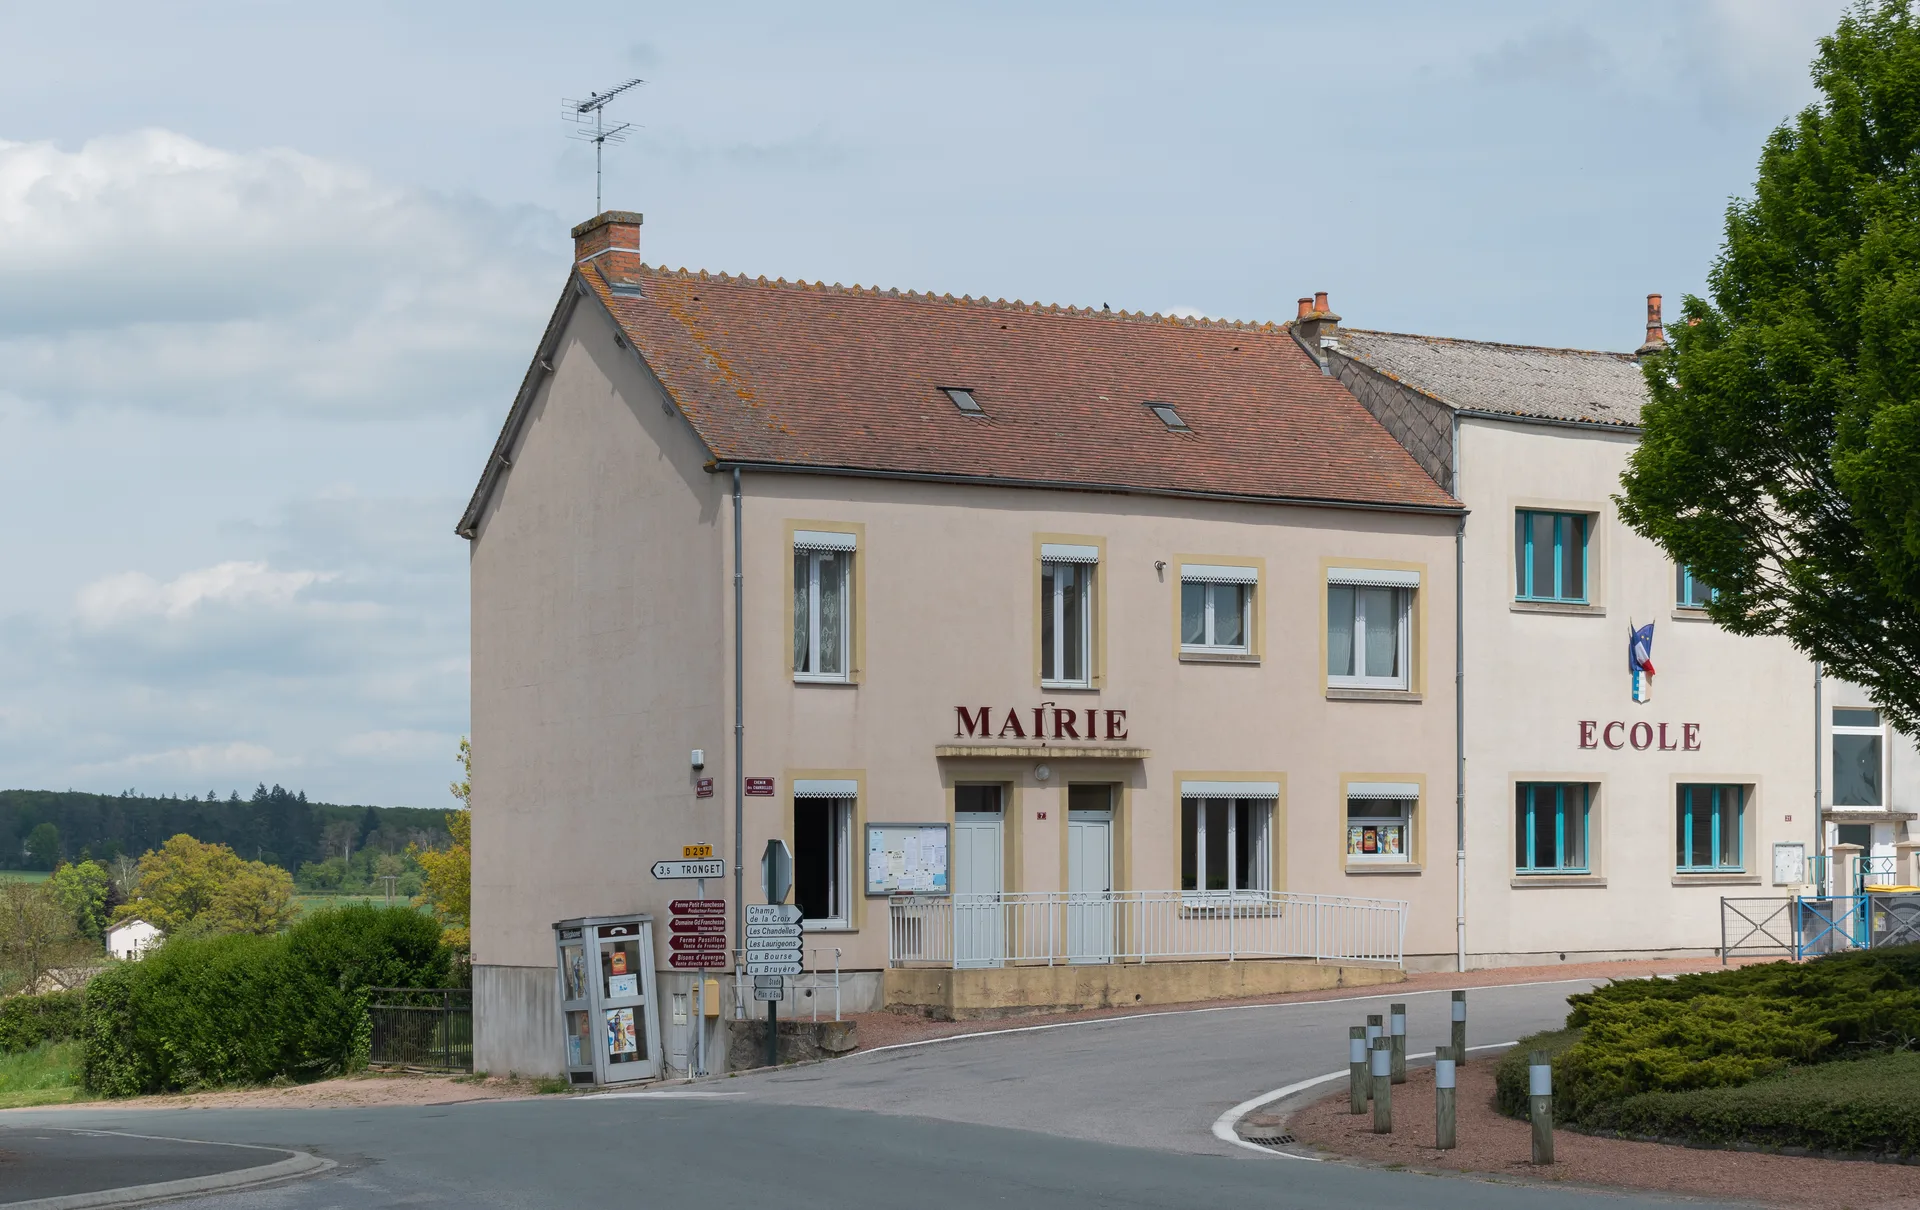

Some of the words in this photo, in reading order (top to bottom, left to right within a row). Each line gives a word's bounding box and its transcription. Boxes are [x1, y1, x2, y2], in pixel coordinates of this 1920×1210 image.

[954, 706, 1129, 740] MAIRIE
[1577, 720, 1702, 751] ECOLE
[686, 848, 690, 856] D
[693, 847, 710, 856] 297
[660, 866, 670, 876] 3,5
[682, 864, 720, 874] TRONGET
[750, 906, 774, 915] Champ
[762, 940, 796, 948] Laurigeons
[696, 954, 724, 962] d'Auvergne
[764, 965, 796, 973] Bruyère
